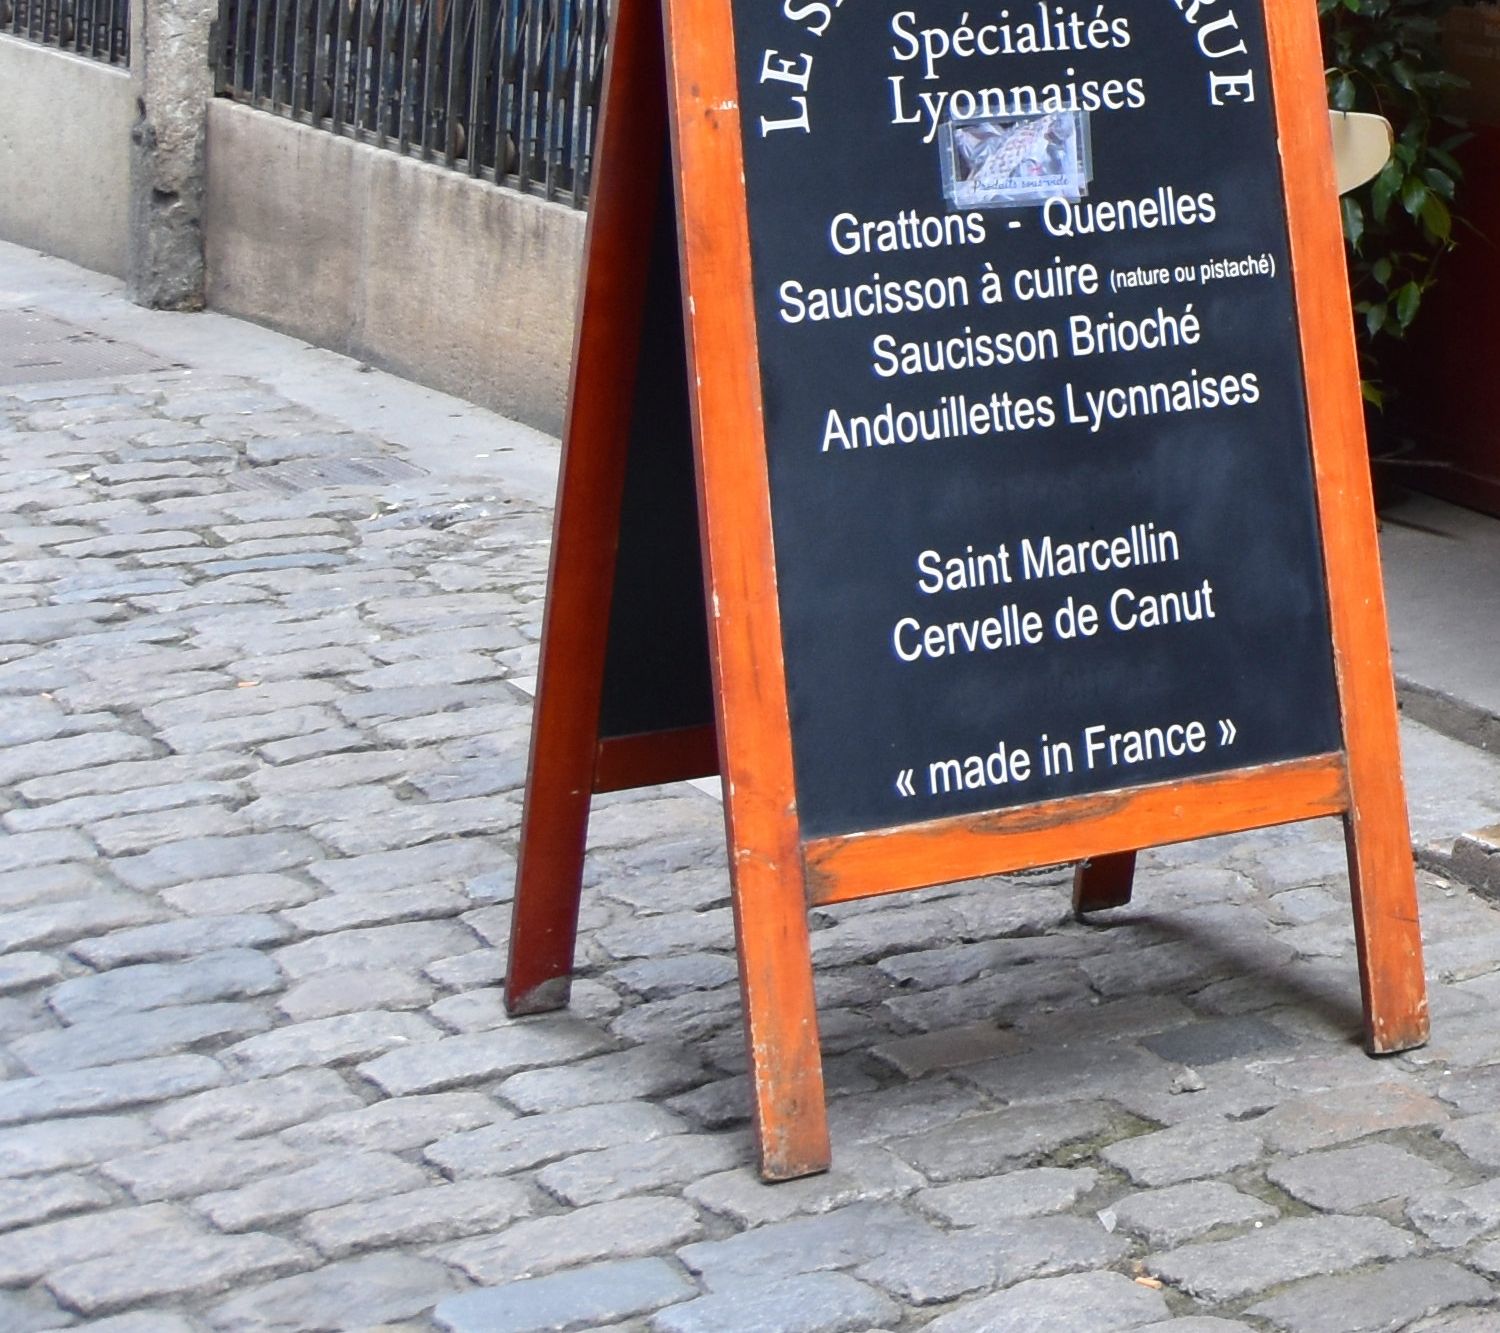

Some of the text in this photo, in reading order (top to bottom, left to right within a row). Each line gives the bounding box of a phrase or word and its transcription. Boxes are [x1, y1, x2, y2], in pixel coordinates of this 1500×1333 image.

[892, 0, 1132, 81] Spécialités
[760, 48, 813, 139] LE
[886, 67, 1147, 145] Lyonnaises
[829, 185, 1218, 256] Grattons Quenelles
[778, 252, 1276, 325] Saucisson à cuire (nature ou pistaché)
[872, 303, 1202, 378] Saucisson Brioché
[821, 393, 1056, 453] Andouillettes
[916, 521, 1181, 596] Saint Marcellin
[892, 578, 1216, 663] Cervelle de Canut
[928, 741, 1032, 796] made
[1041, 733, 1075, 776] in
[1083, 715, 1207, 772] France
